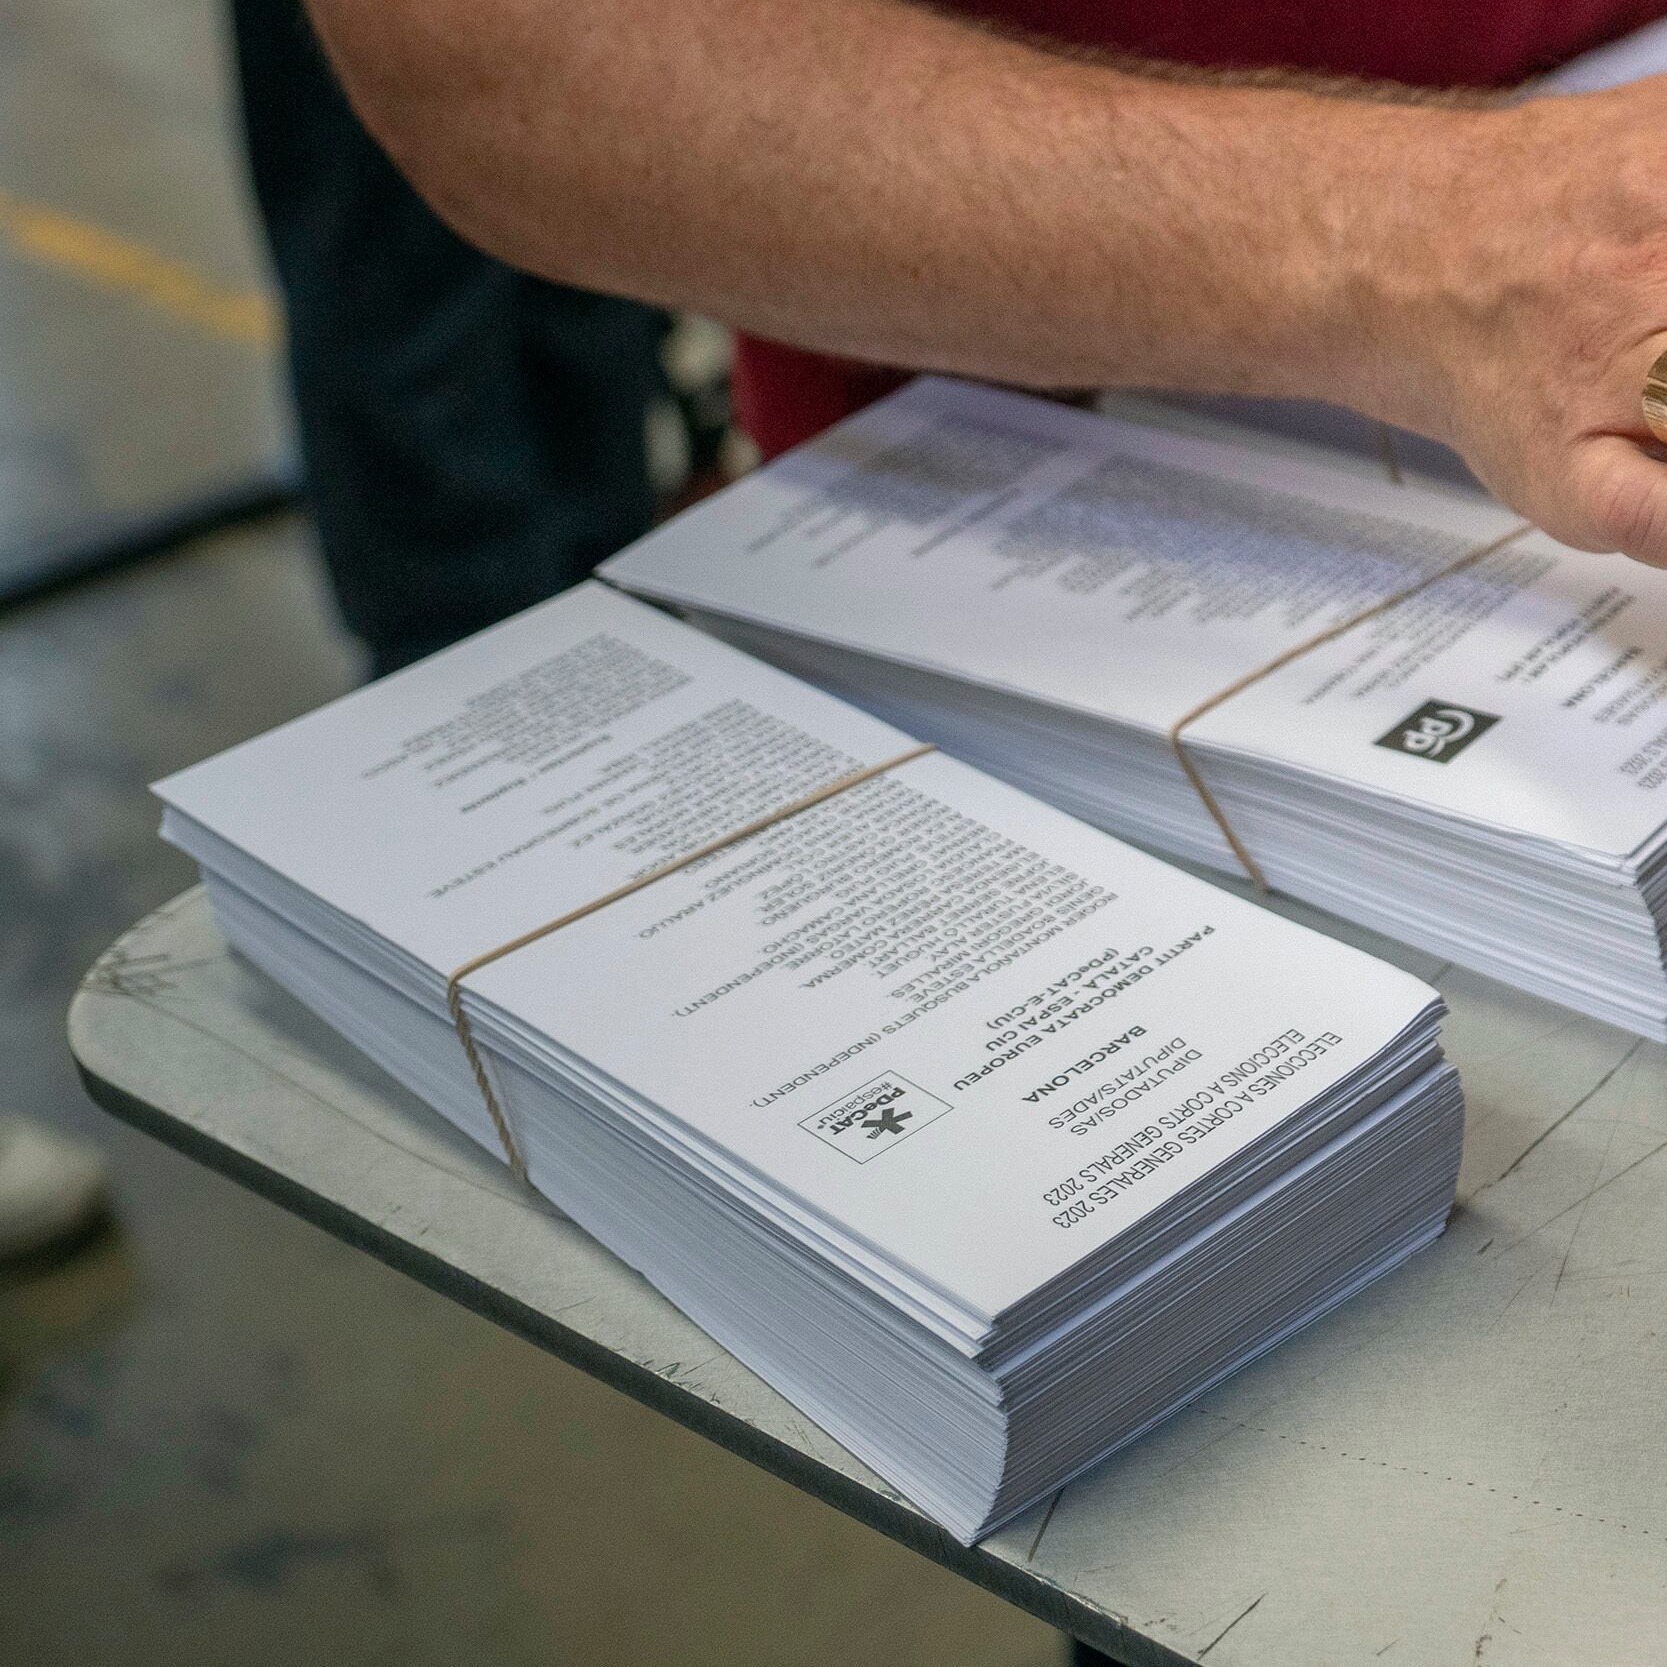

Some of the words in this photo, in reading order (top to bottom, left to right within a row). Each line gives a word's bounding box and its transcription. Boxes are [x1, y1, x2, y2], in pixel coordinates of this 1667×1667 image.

[1616, 752, 1656, 776] 2023
[1082, 947, 1153, 989] CATALÀ
[1155, 926, 1215, 966] PARTIT
[882, 977, 970, 1034] BUSQUETS
[1018, 996, 1073, 1030] ESPAI
[1041, 965, 1154, 1033] DEMÒCRATA
[953, 1035, 1043, 1090] EUROPEU
[986, 1031, 1018, 1051] CIU
[1022, 1026, 1146, 1102] BARCELONA
[1220, 1029, 1305, 1087] ELECCIONS
[1248, 1032, 1342, 1095] ELECCIONES
[748, 1031, 882, 1110] (INDEPENDENT).
[1049, 1037, 1186, 1129] DIPUTATS/ADES
[1070, 1049, 1202, 1136] DIPUTADOS/AS
[1207, 1082, 1225, 1094] A
[830, 1086, 906, 1135] PDeCAT
[1158, 1092, 1214, 1129] CORTS
[1235, 1091, 1254, 1102] A
[1178, 1101, 1243, 1144] CORTES
[1079, 1126, 1163, 1182] GENERALS
[1089, 1142, 1183, 1204] GENERALES
[1043, 1178, 1084, 1206] 2023
[1052, 1200, 1095, 1228] 2023
